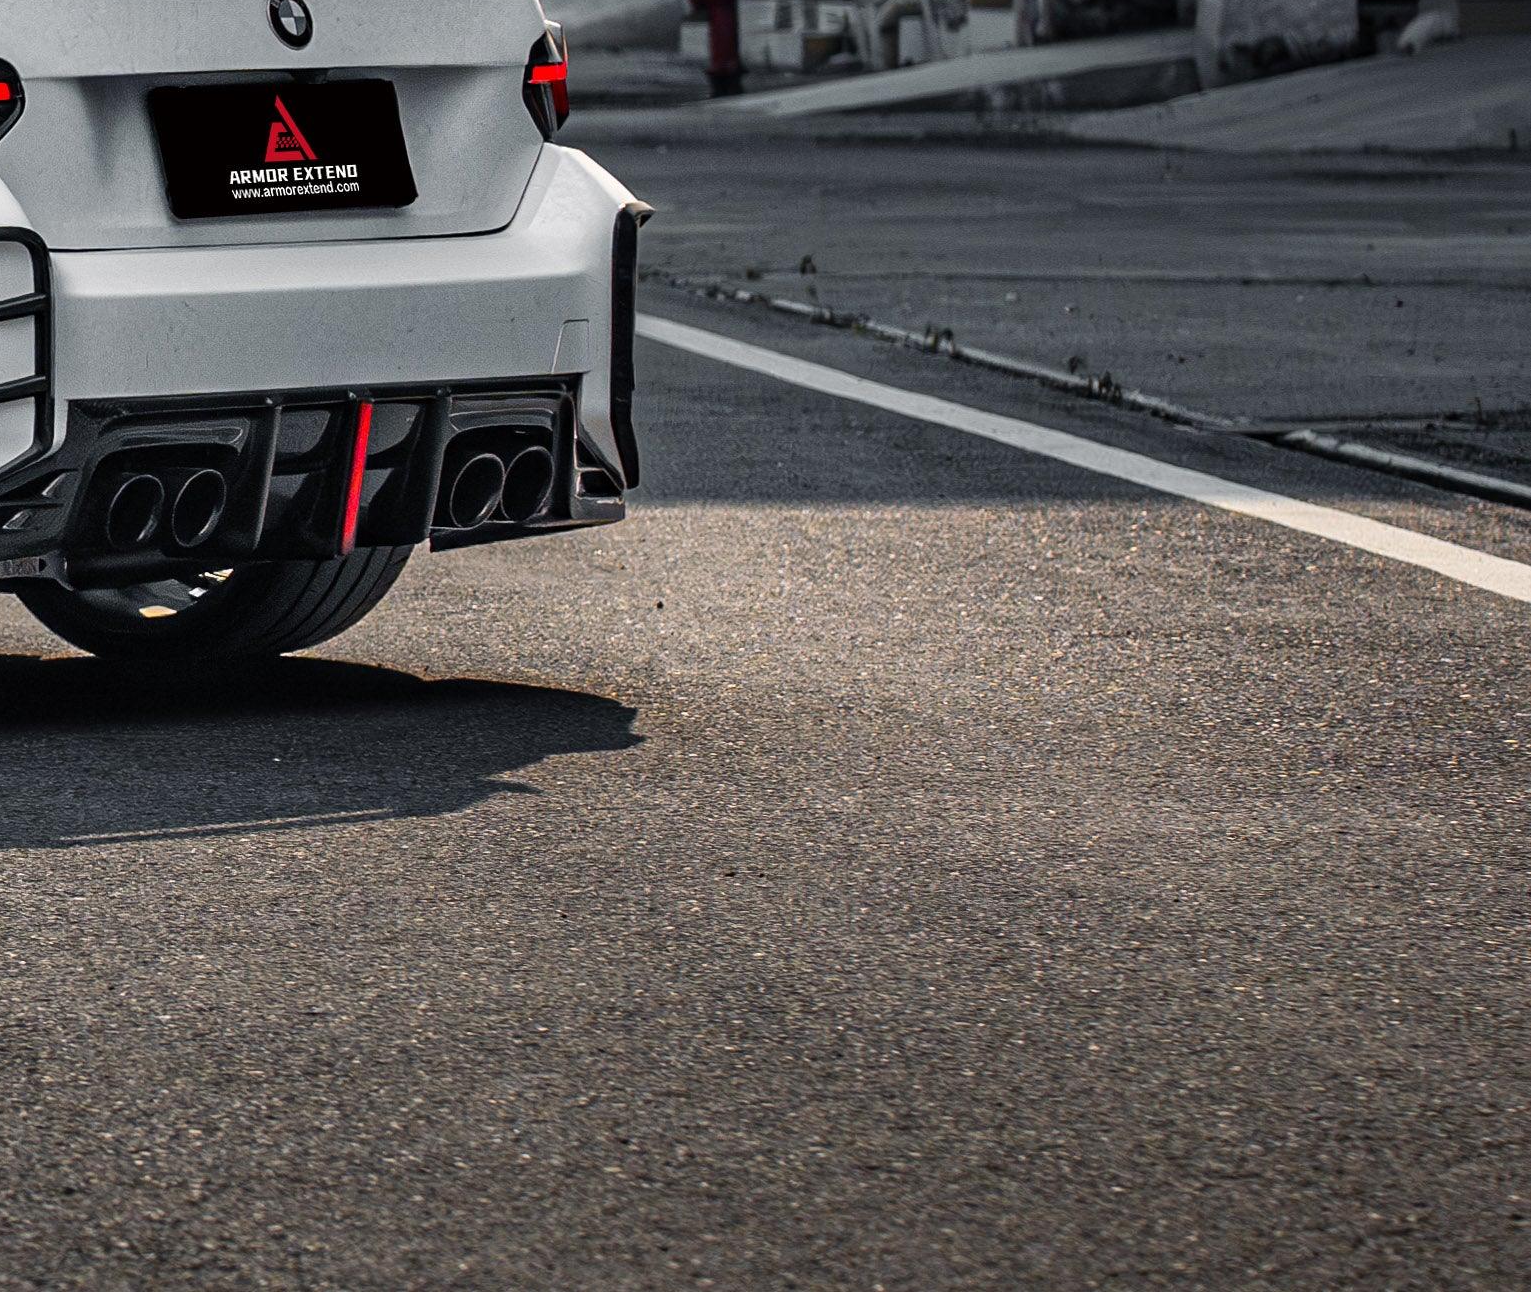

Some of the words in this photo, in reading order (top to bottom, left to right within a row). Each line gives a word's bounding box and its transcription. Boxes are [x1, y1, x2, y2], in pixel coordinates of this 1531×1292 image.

[230, 167, 288, 185] ARMOR
[293, 164, 359, 182] EXTEND
[231, 181, 360, 199] www.armorextend.com
